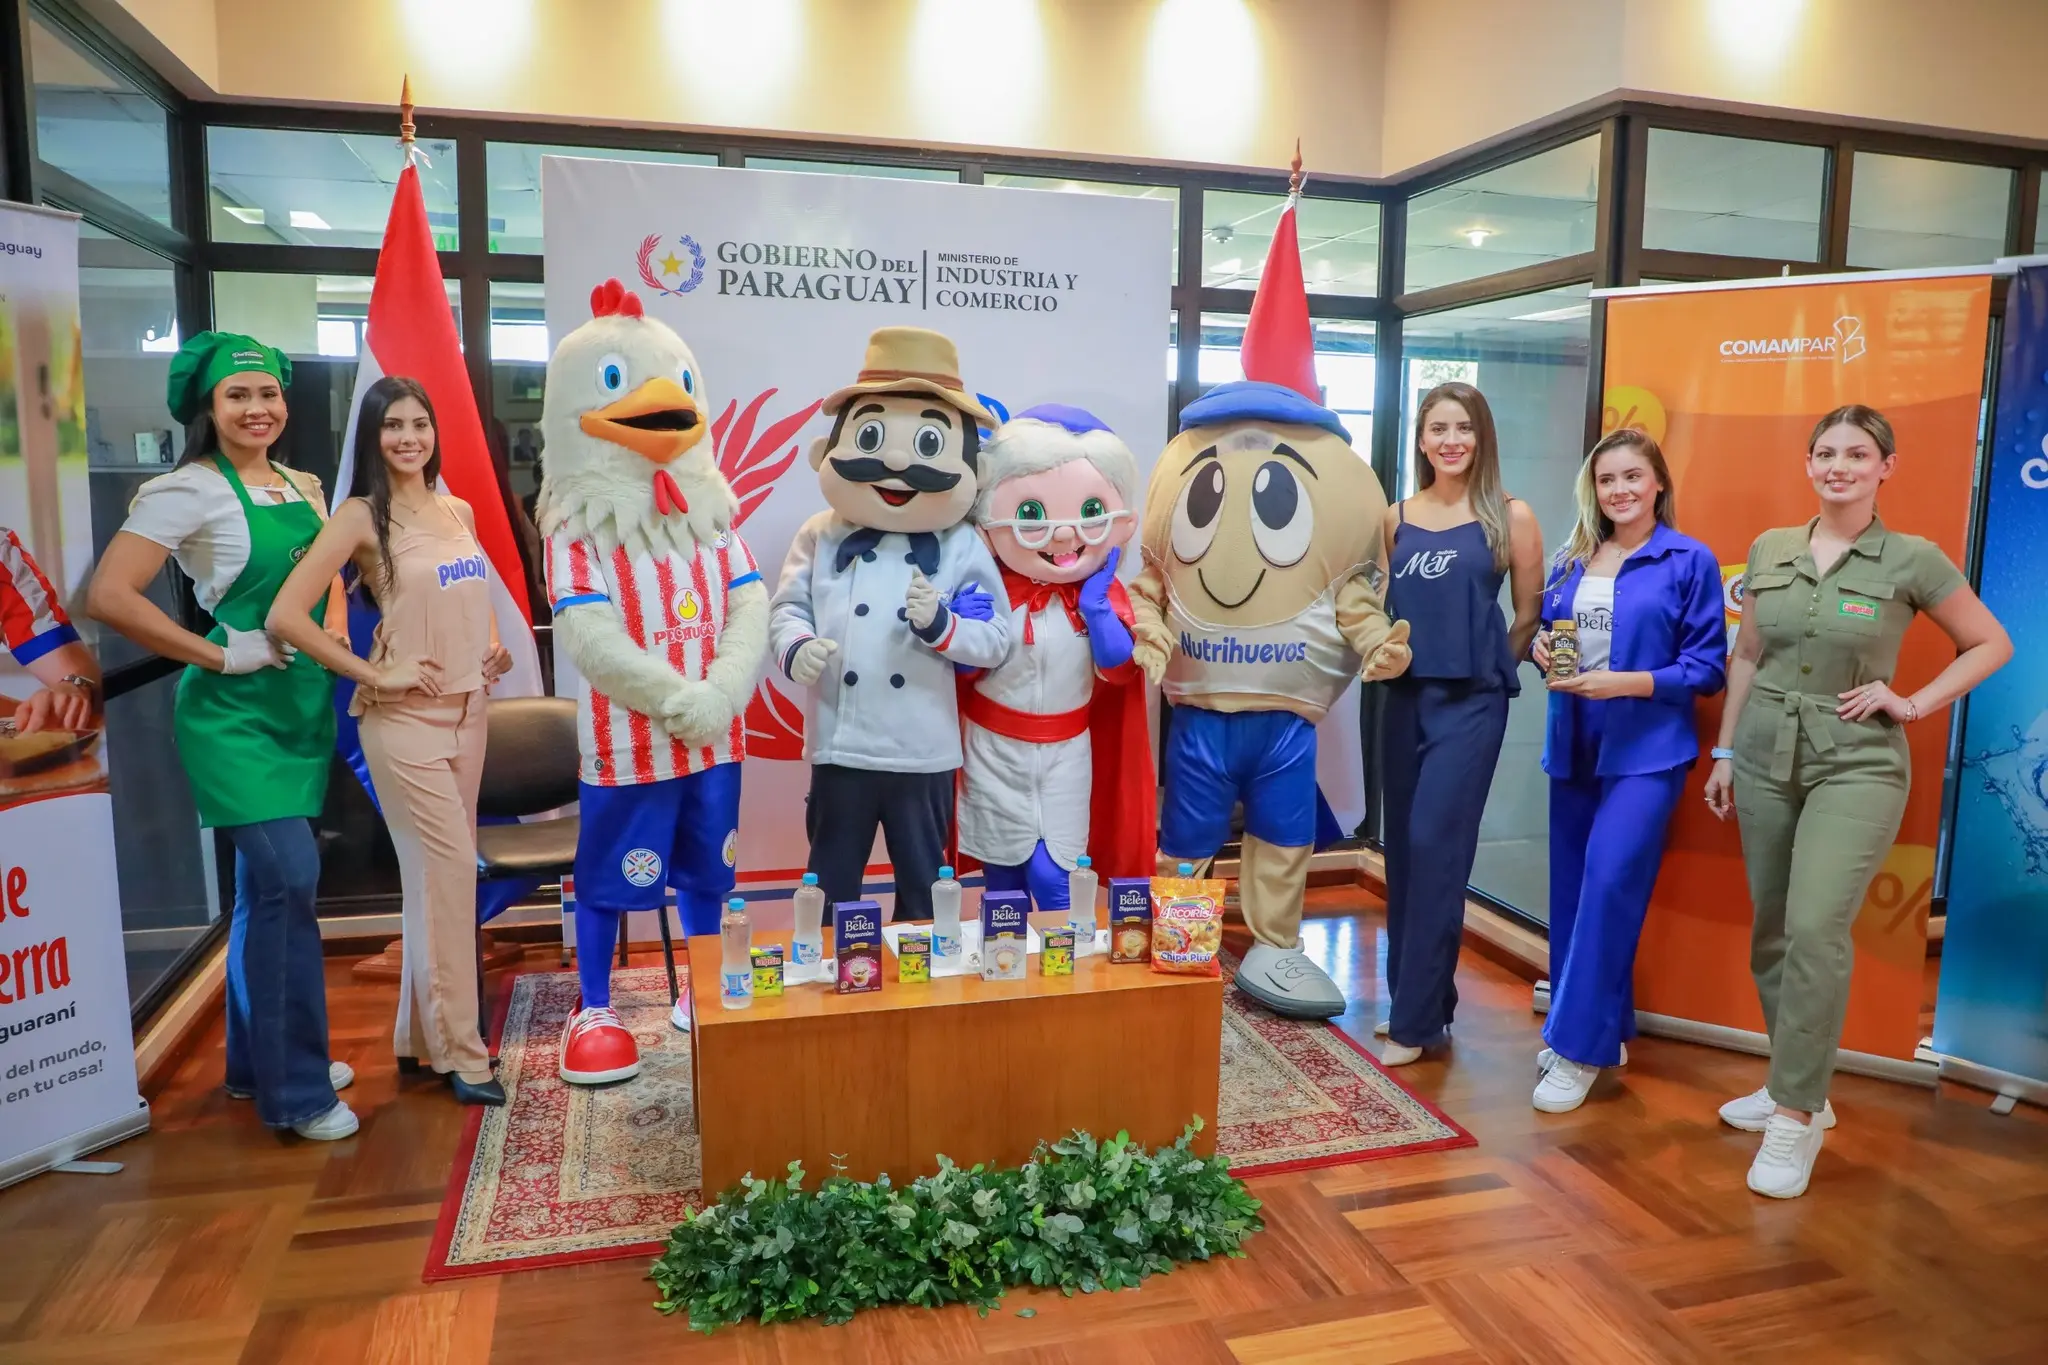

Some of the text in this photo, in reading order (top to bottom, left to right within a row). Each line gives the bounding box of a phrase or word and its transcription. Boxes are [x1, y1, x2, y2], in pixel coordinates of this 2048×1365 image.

[717, 241, 918, 273] GOBIERNO DEL
[938, 253, 1018, 266] MINISTERIO DE
[717, 268, 917, 304] PARAGUAY
[936, 266, 1078, 290] INDUSTRIA Y
[936, 290, 1058, 312] COMERCIO
[1719, 336, 1837, 356] COMAMPAR
[1395, 550, 1458, 579] Mar
[653, 622, 715, 646] PECHUGO
[1181, 631, 1306, 663] Nutrihuevos
[1119, 894, 1147, 905] Belén
[845, 917, 875, 931] Belén
[992, 909, 1021, 920] Belén
[1160, 951, 1211, 963] Chipa Pirú
[6, 1040, 107, 1080] del mundo,
[6, 1059, 104, 1103] en tu casa!
